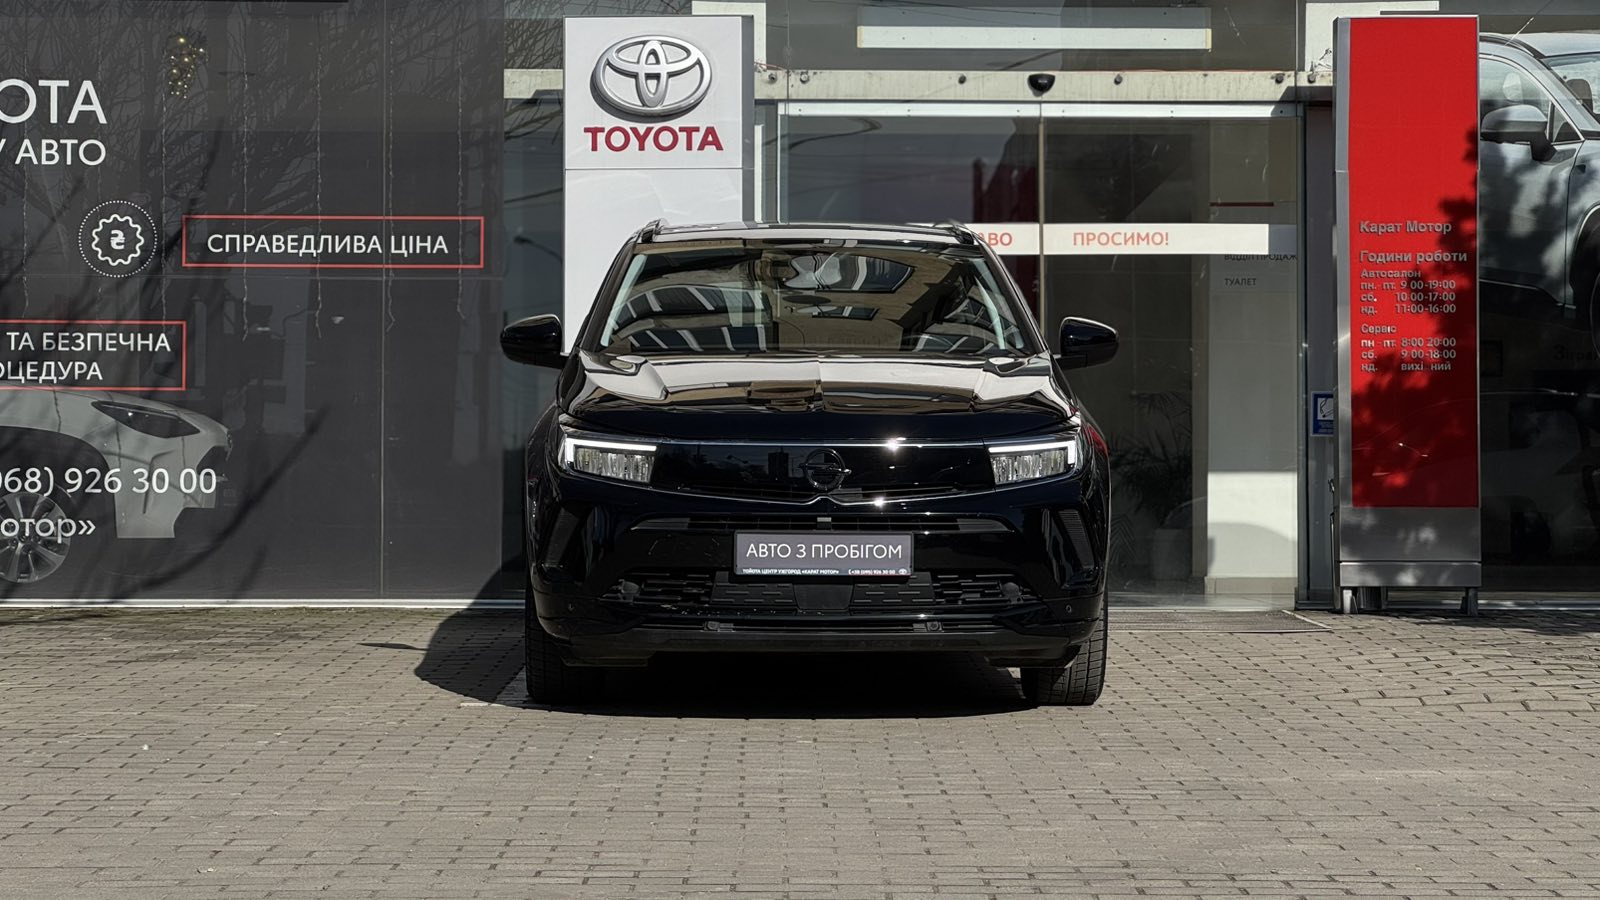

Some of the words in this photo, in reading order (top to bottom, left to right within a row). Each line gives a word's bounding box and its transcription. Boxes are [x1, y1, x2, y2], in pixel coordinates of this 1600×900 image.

[583, 126, 724, 152] TOYOTA
[14, 138, 107, 166] АВТО
[1359, 220, 1402, 235] Карат
[1406, 220, 1452, 235] Мотор
[206, 233, 383, 258] СПРАВЕДЛИВА
[390, 234, 449, 258] ЦІНА
[1072, 231, 1169, 247] ПРОСИМО!
[1359, 250, 1412, 264] Години
[1360, 269, 1421, 278] Автосалон
[1224, 277, 1257, 286] ТУАЛЕТ
[1400, 279, 1456, 290] 900-19:00
[1360, 291, 1377, 302] сб.
[1360, 305, 1378, 316] нд.
[1395, 303, 1457, 314] 11:00-16:00
[1360, 323, 1397, 335] Сервіс
[6, 331, 35, 351] ТА
[42, 331, 171, 353] БЕЗПЕЧНА
[1360, 349, 1377, 359] сб.
[1360, 363, 1378, 373] нд.
[0, 466, 54, 497] 68)
[64, 467, 122, 494] 926
[132, 467, 169, 494] 30
[179, 467, 217, 494] 00
[0, 518, 96, 544] отор»
[746, 543, 792, 559] АВТО
[796, 544, 807, 559] З
[811, 543, 902, 560] ПРОБІГОМ
